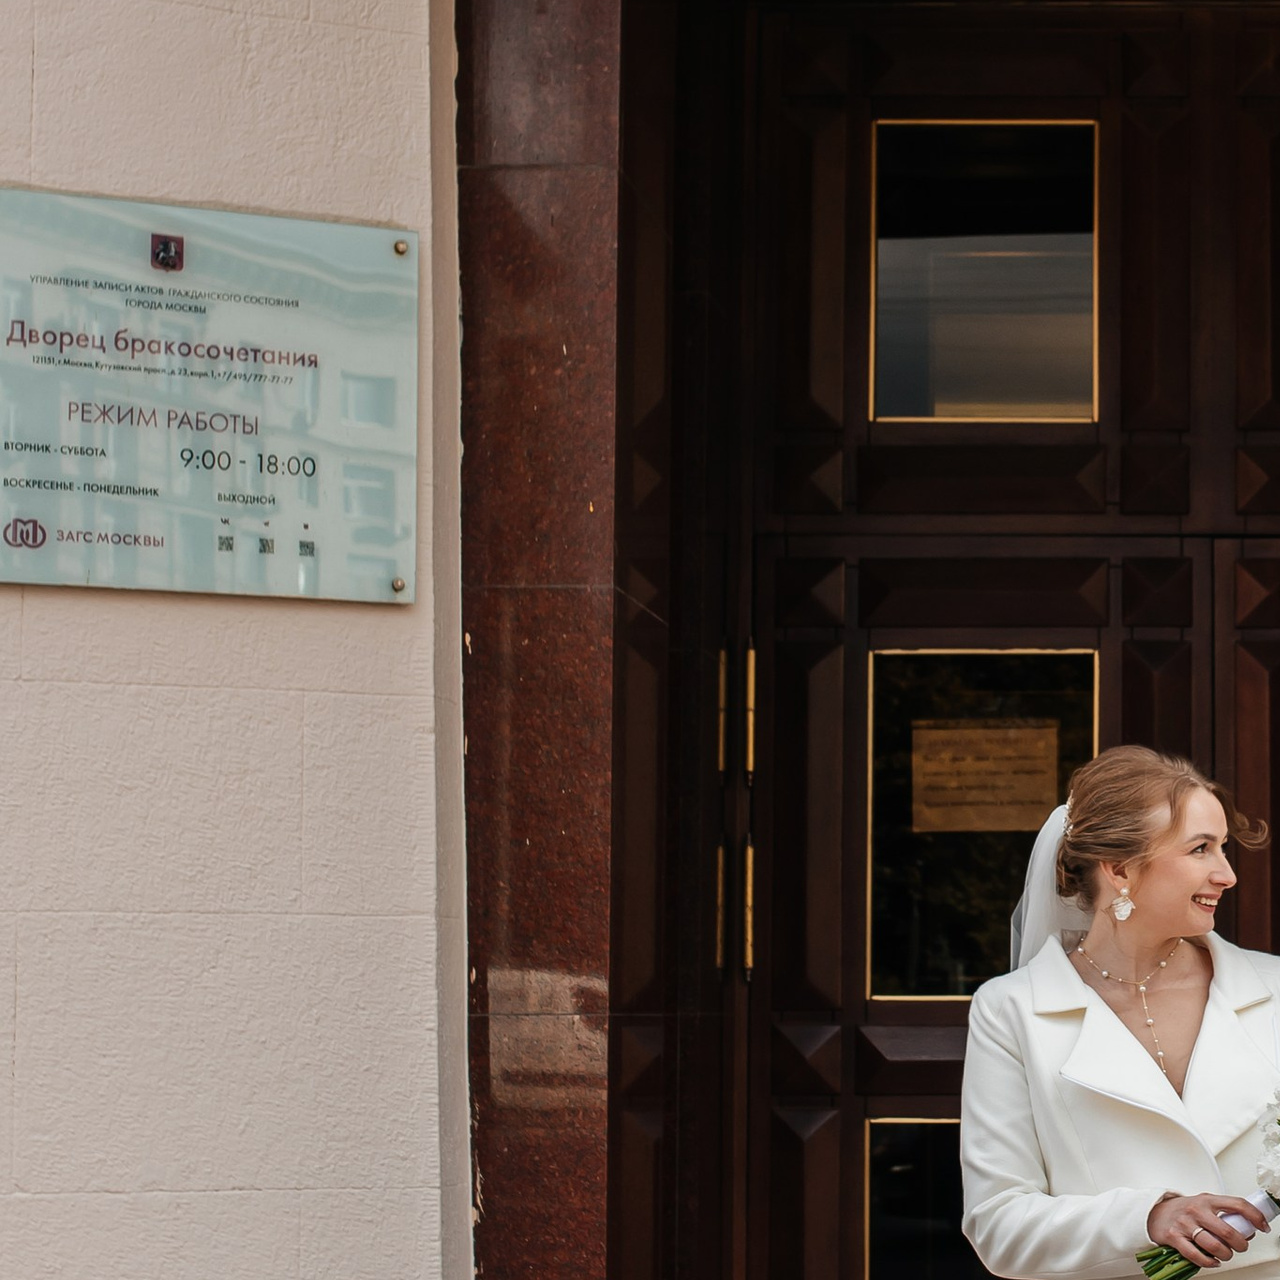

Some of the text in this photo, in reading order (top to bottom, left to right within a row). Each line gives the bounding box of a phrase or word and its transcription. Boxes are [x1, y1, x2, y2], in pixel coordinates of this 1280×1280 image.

[30, 274, 300, 308] УПРАВЛЕНИЕ ЗАПИСИ АКТОВ ГРАЖДАНСКОГО СОСТОЯНИЯ
[125, 298, 207, 315] ГОРОДА МОСКВЫ
[6, 319, 319, 369] Дворец бракосочетания
[67, 401, 259, 436] РЕЖИМ РАБОТЫ
[4, 441, 51, 454] ВТОРНИК
[60, 445, 107, 458] СУББОТА
[180, 448, 231, 471] 9:00
[257, 453, 316, 477] 18:00
[3, 477, 75, 492] ВОСКРЕСЕНЬЕ
[83, 482, 160, 497] ПОНЕДЕЛЬНИК
[217, 492, 276, 506] ВЫХОДНОЙ
[56, 529, 165, 548] ЗАГС МОСКВЫ
